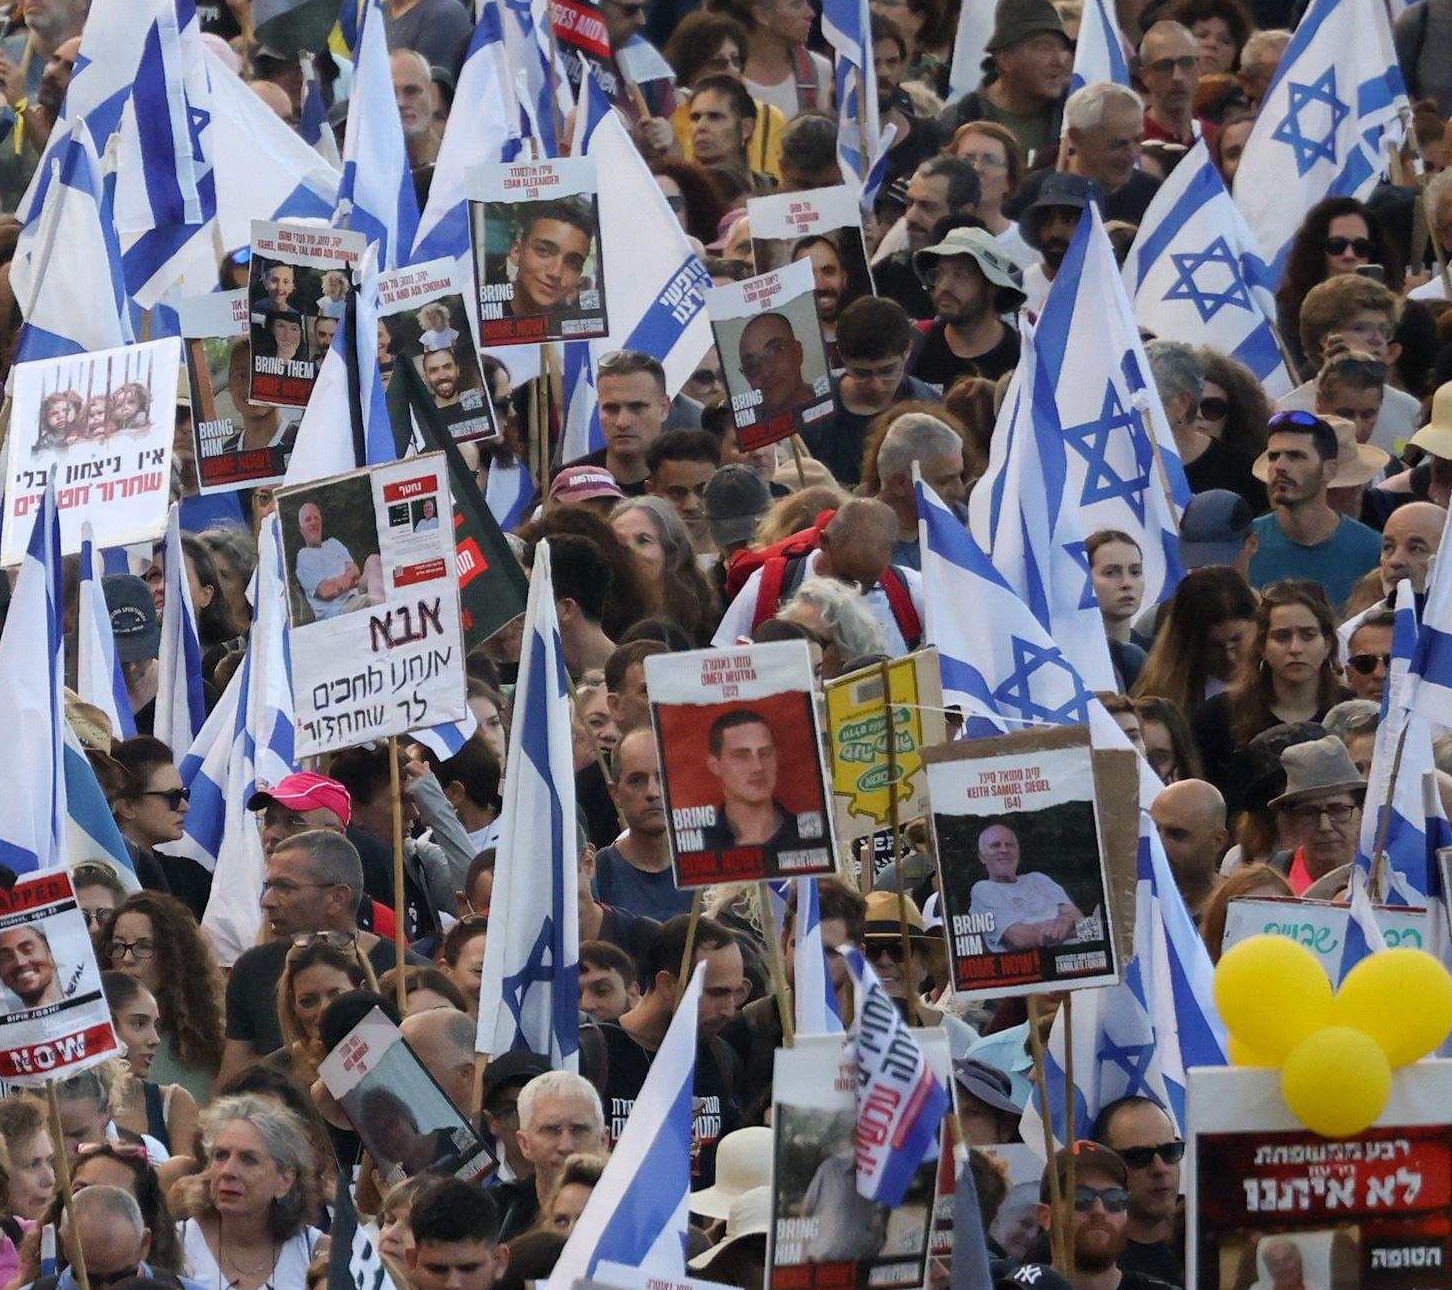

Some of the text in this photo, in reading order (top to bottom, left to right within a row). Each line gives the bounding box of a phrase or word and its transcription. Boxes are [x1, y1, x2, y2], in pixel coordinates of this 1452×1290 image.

[504, 175, 559, 189] EDAN ALEXANDER
[526, 187, 538, 198] (19)
[479, 283, 513, 302] BRING
[481, 302, 504, 319] HIM
[255, 355, 314, 379] BRING THEM
[732, 389, 763, 412] BRING
[198, 418, 235, 440] BRING
[735, 408, 756, 428] HIM
[200, 439, 225, 458] HIM
[16, 448, 164, 486] אין ניצחון בלי
[101, 471, 162, 497] שחרור
[399, 482, 421, 496] נחטף
[369, 597, 443, 651] אבא
[312, 646, 450, 709] אנחנו מחכים
[701, 669, 756, 685] OMER NEUTRA
[722, 683, 738, 698] (22)
[303, 690, 426, 745] לך שתחזור
[967, 779, 1051, 798] KEITH SAMUEL SIEGEL
[1003, 794, 1021, 809] (64)
[672, 805, 715, 831] BRING
[677, 828, 704, 851] HIM
[952, 912, 995, 935] BRING
[955, 933, 982, 956] HIM
[64, 959, 85, 996] NEPAL
[957, 953, 1039, 979] HOME NOW!
[9, 1031, 86, 1073] NOW
[1253, 1136, 1410, 1166] רבע ממשפחת
[1242, 1167, 1422, 1213] לא איתנו
[776, 1218, 820, 1242] BRING
[776, 1241, 803, 1265] HIM
[1014, 1265, 1044, 1285] NY
